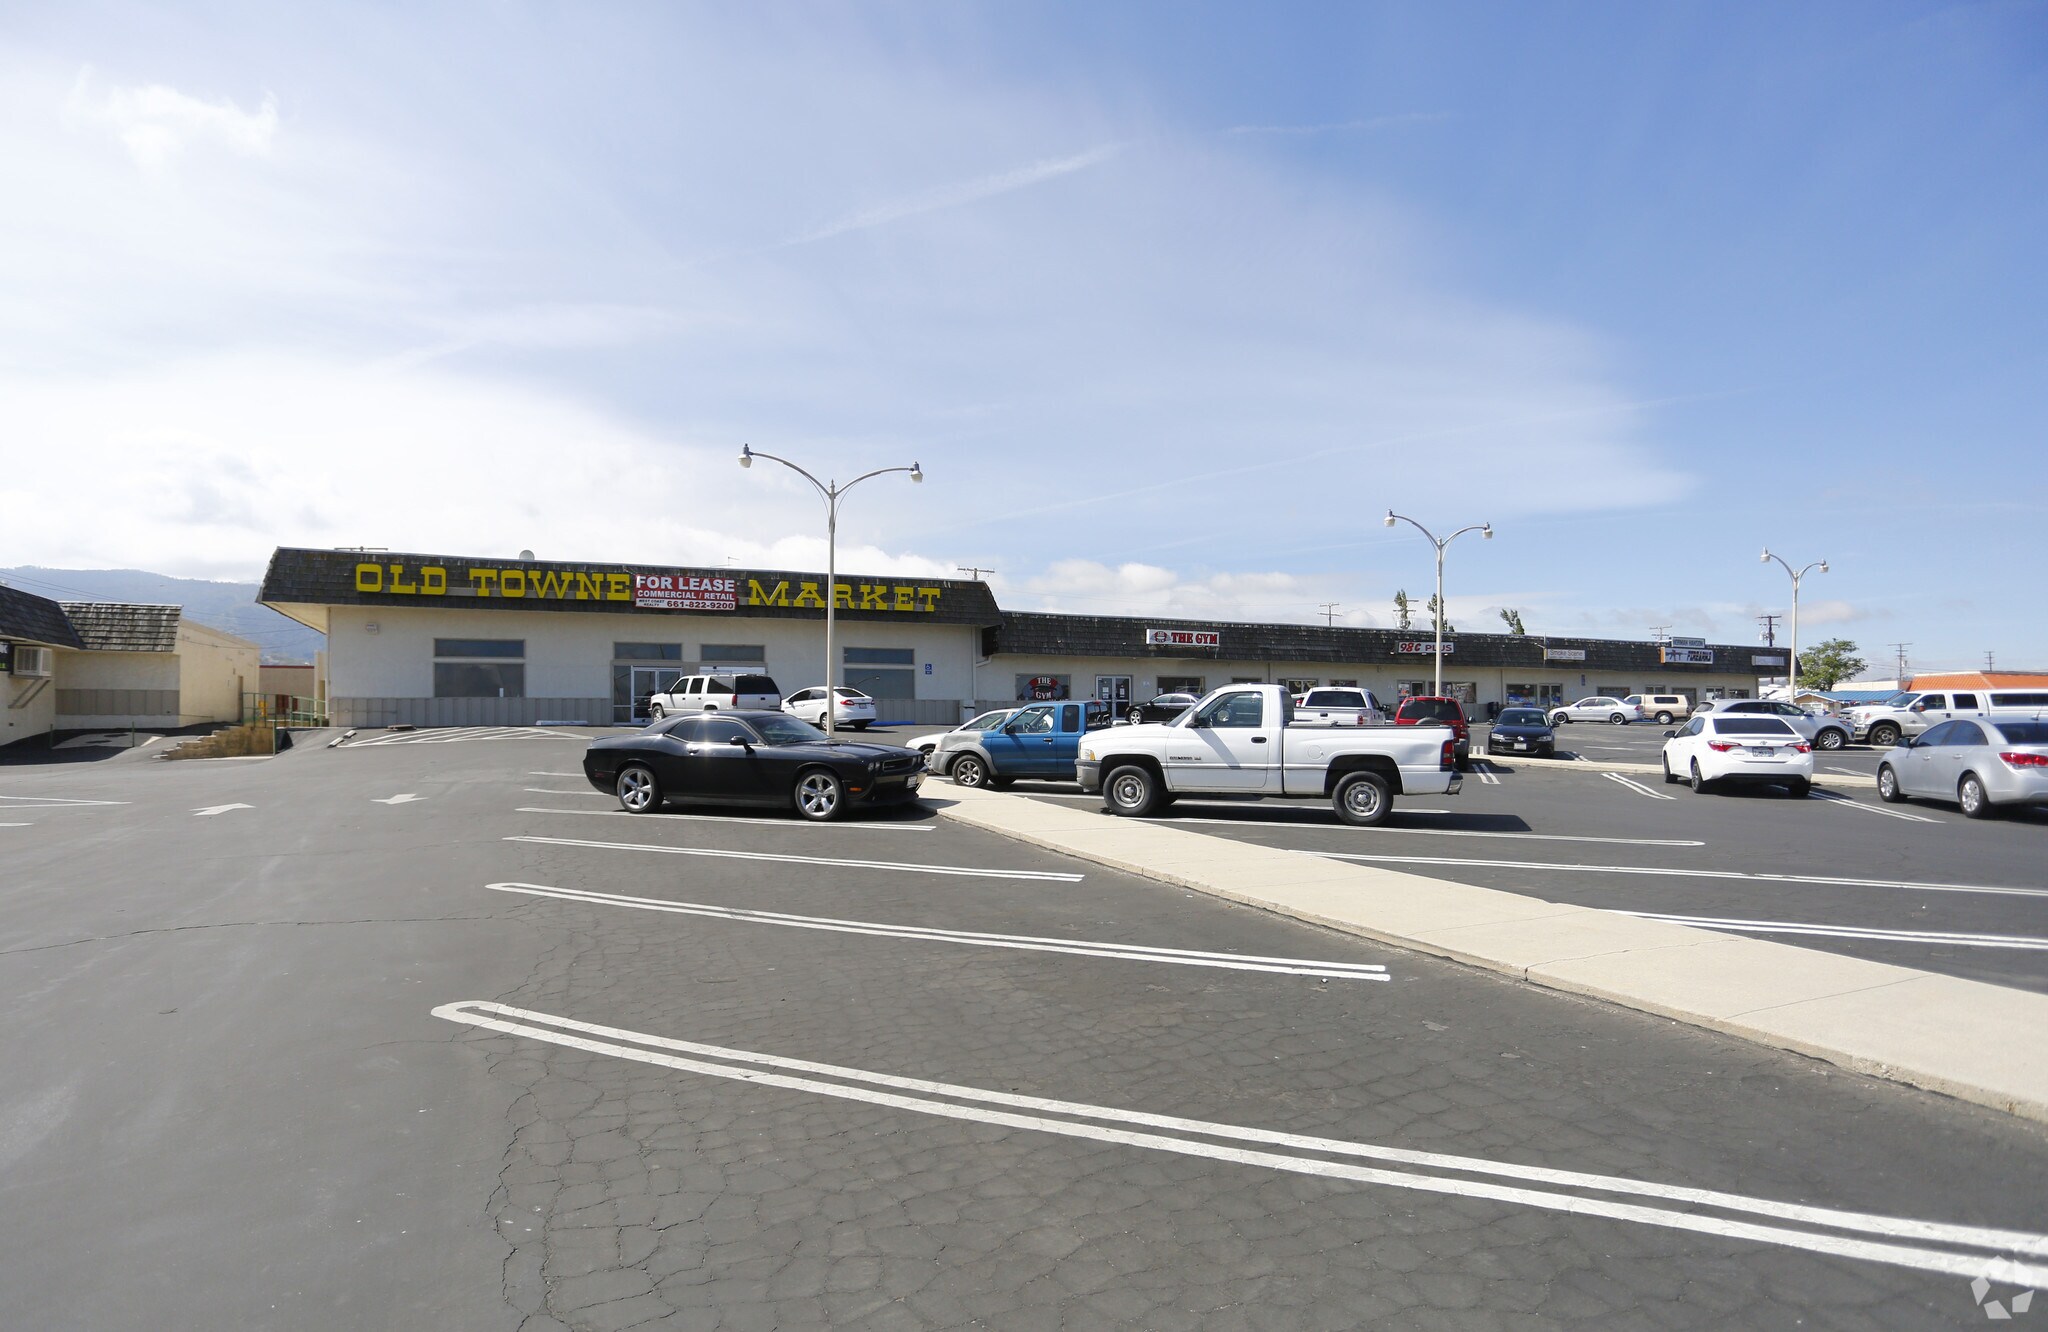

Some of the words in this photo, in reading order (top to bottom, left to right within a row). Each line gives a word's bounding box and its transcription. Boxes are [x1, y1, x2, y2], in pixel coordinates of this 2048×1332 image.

[355, 563, 447, 596] OLD
[469, 567, 631, 601] TOWNE
[748, 578, 942, 612] MARKET
[636, 575, 673, 590] FOR
[678, 577, 735, 592] LEASE
[637, 590, 697, 599] COMMERCIAL
[704, 592, 735, 600] RETAIL
[666, 600, 734, 609] 661-822-9200
[1170, 632, 1194, 644] THE
[1195, 633, 1218, 645] GYM
[1036, 676, 1052, 685] THE
[1035, 691, 1052, 700] GYM
